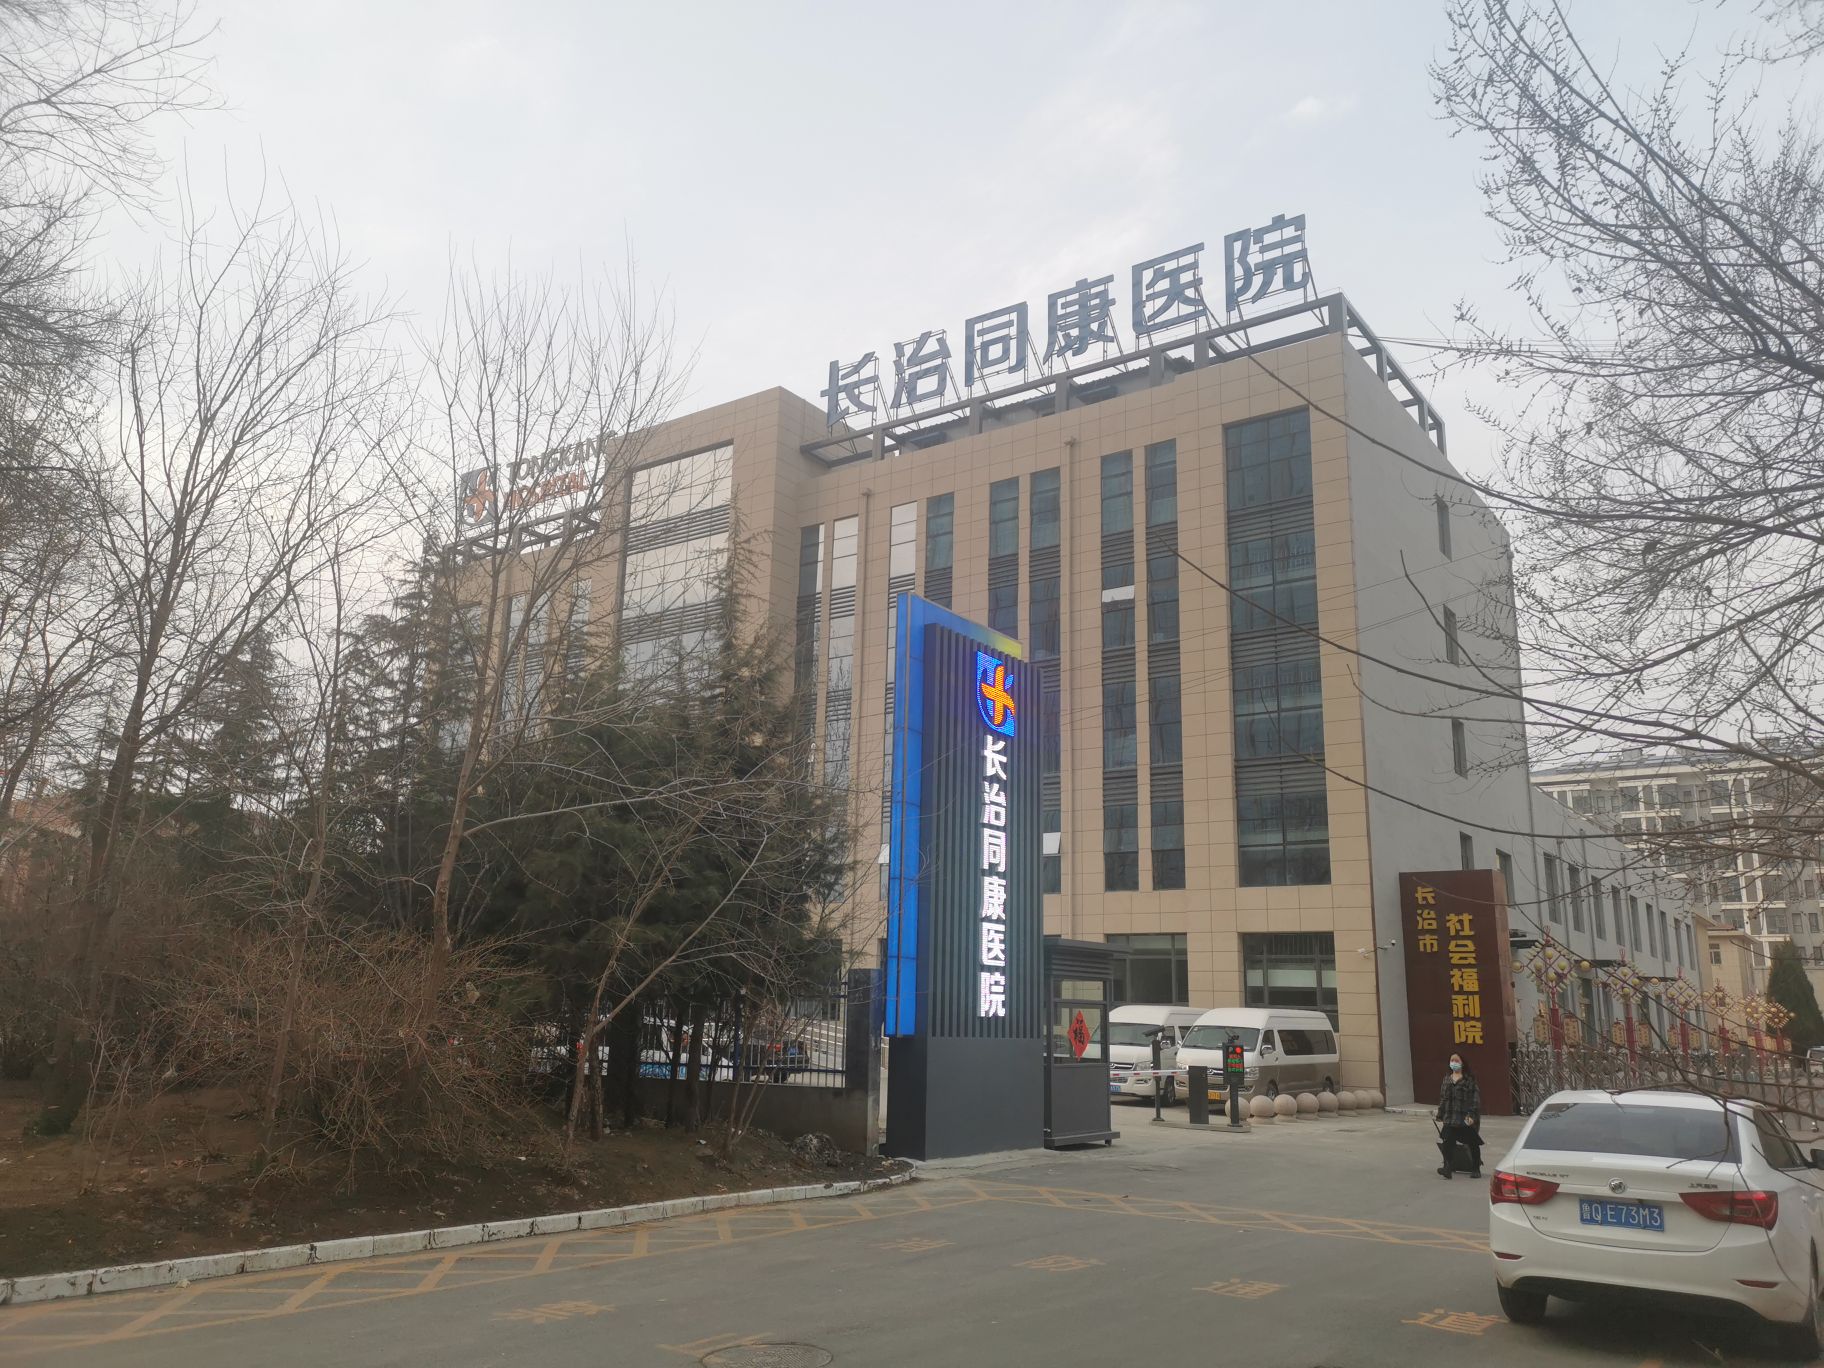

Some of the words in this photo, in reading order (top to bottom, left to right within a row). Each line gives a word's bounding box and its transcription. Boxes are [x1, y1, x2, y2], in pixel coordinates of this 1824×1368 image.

[820, 213, 1310, 428] 长治同康医院
[977, 735, 1008, 1018] 长治同康医院
[1415, 886, 1438, 953] 长治市
[1446, 912, 1484, 1045] 社会福利院
